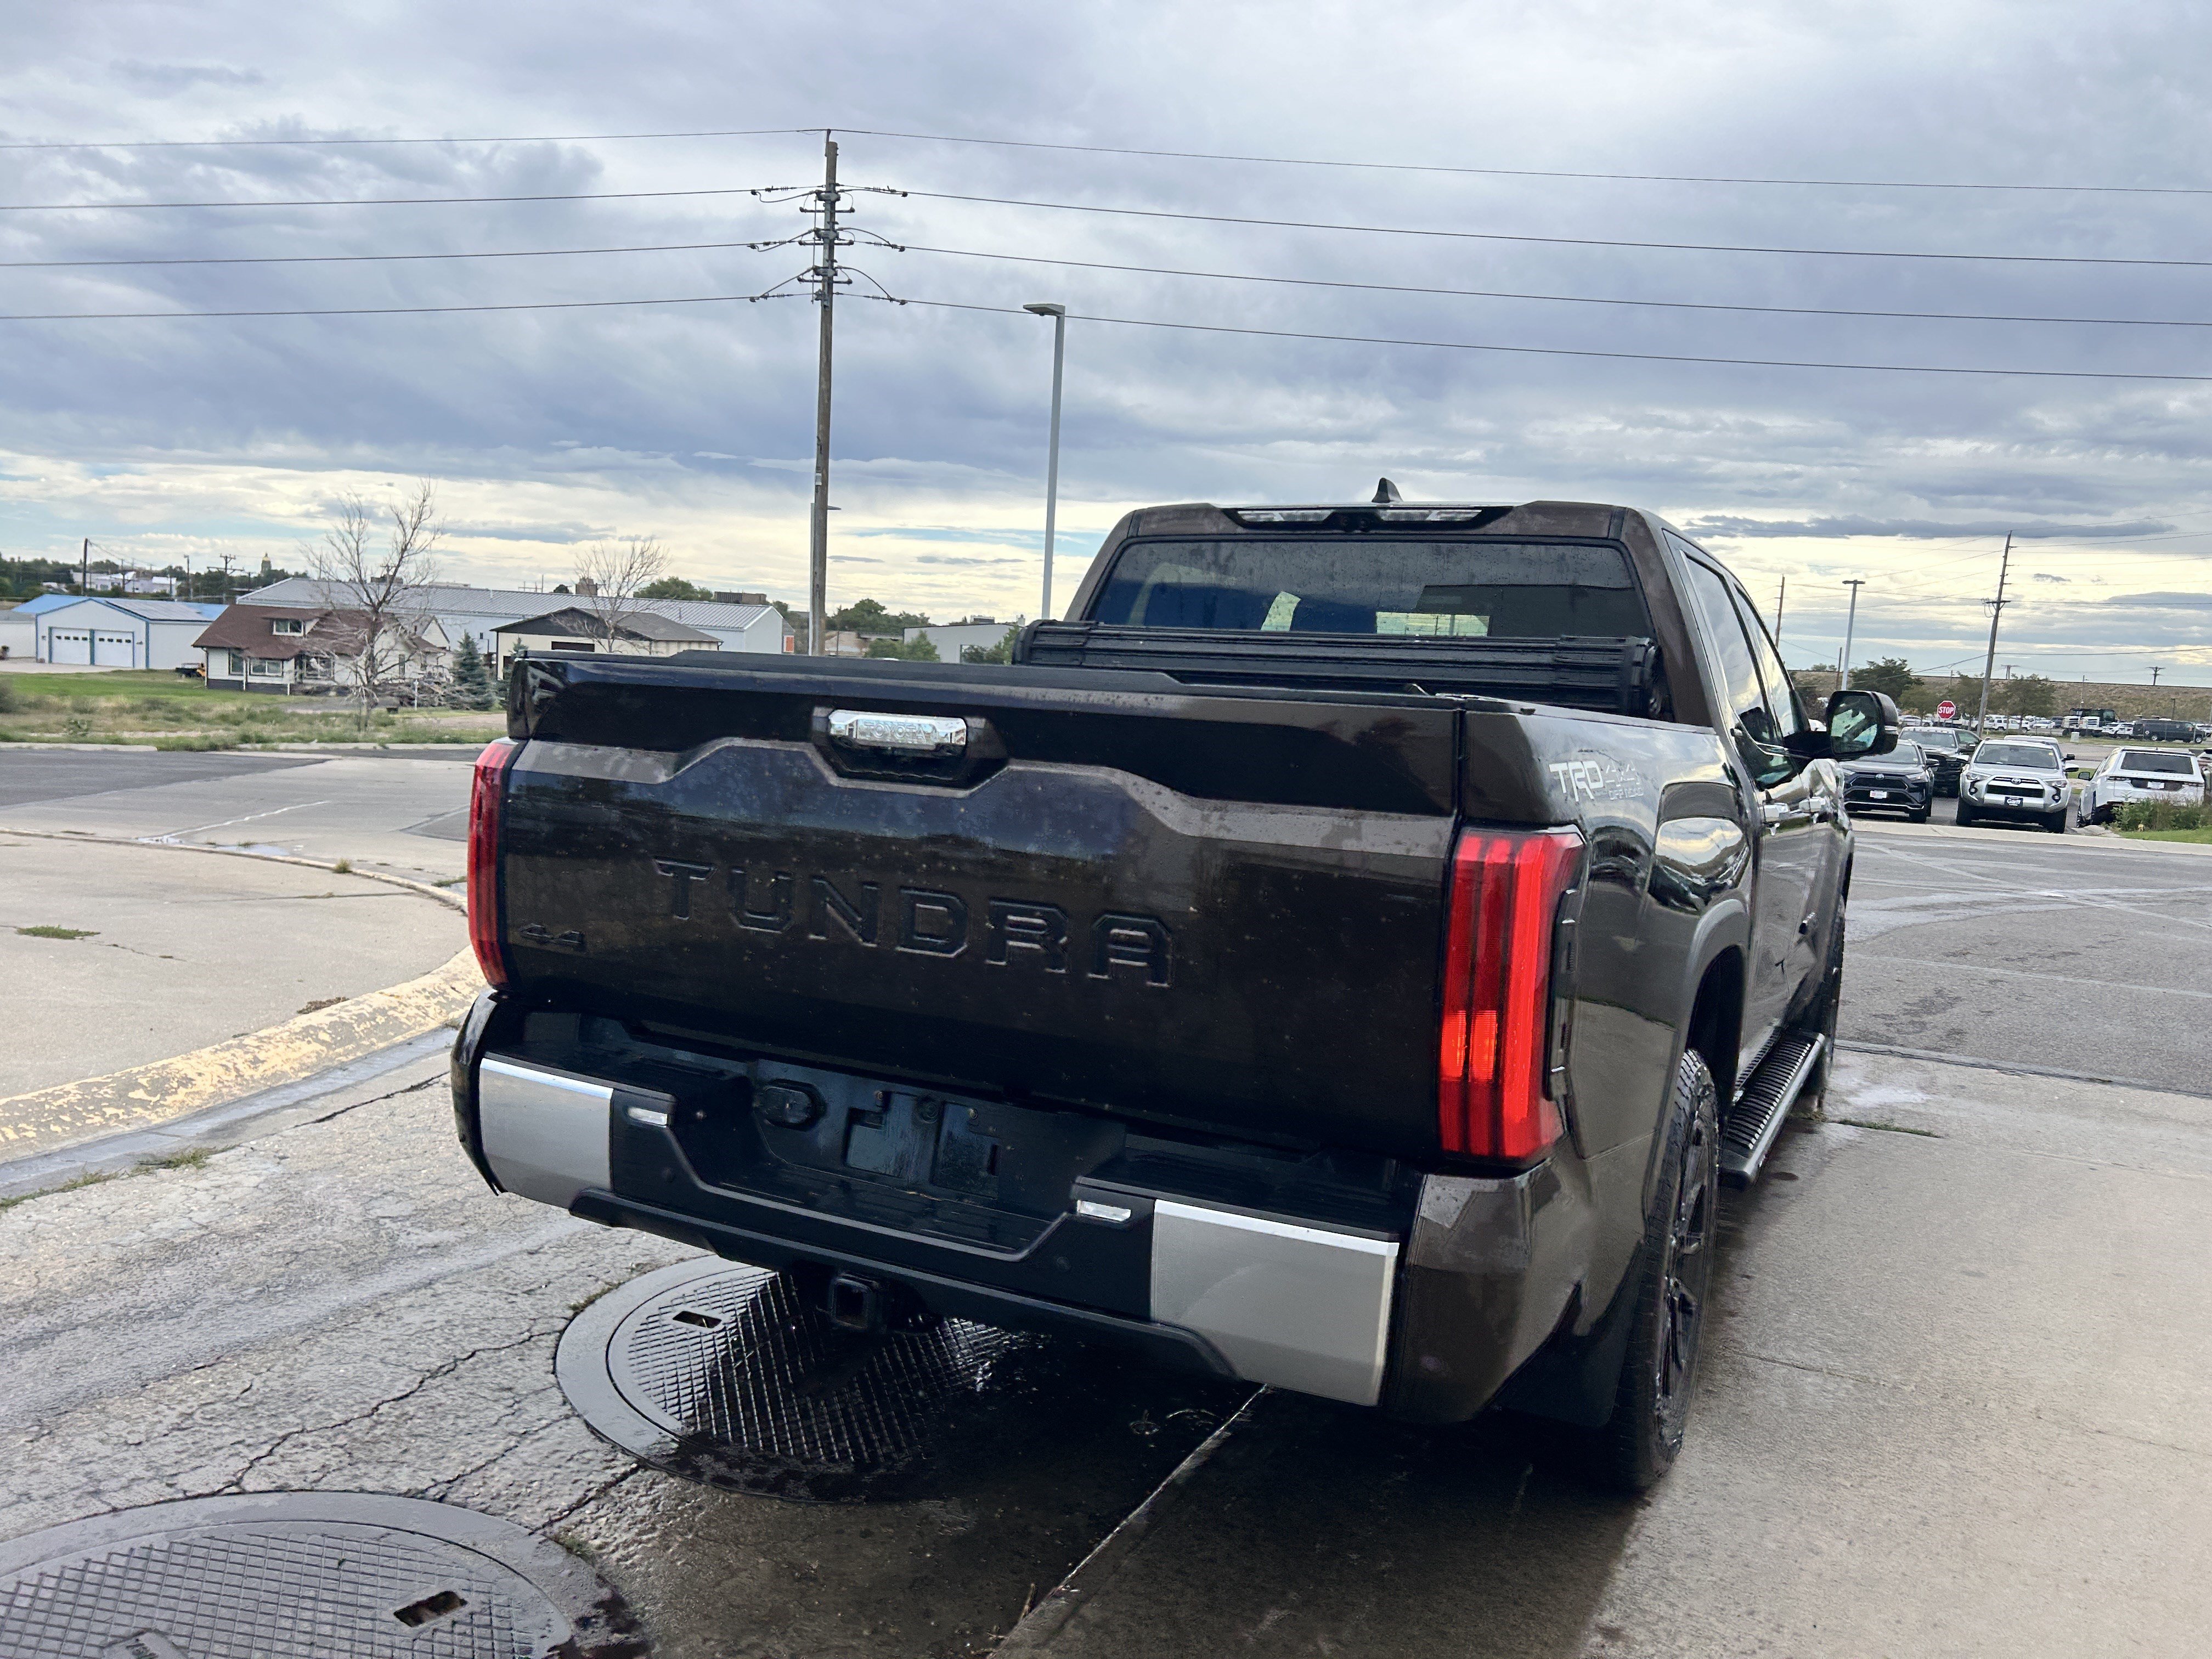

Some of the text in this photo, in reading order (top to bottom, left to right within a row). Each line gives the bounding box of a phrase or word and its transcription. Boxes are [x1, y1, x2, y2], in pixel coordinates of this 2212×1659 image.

[1938, 706, 1954, 714] STOP
[863, 720, 927, 744] TOYOTA
[1548, 760, 1604, 802] TRD
[653, 856, 1174, 988] TUNDRA
